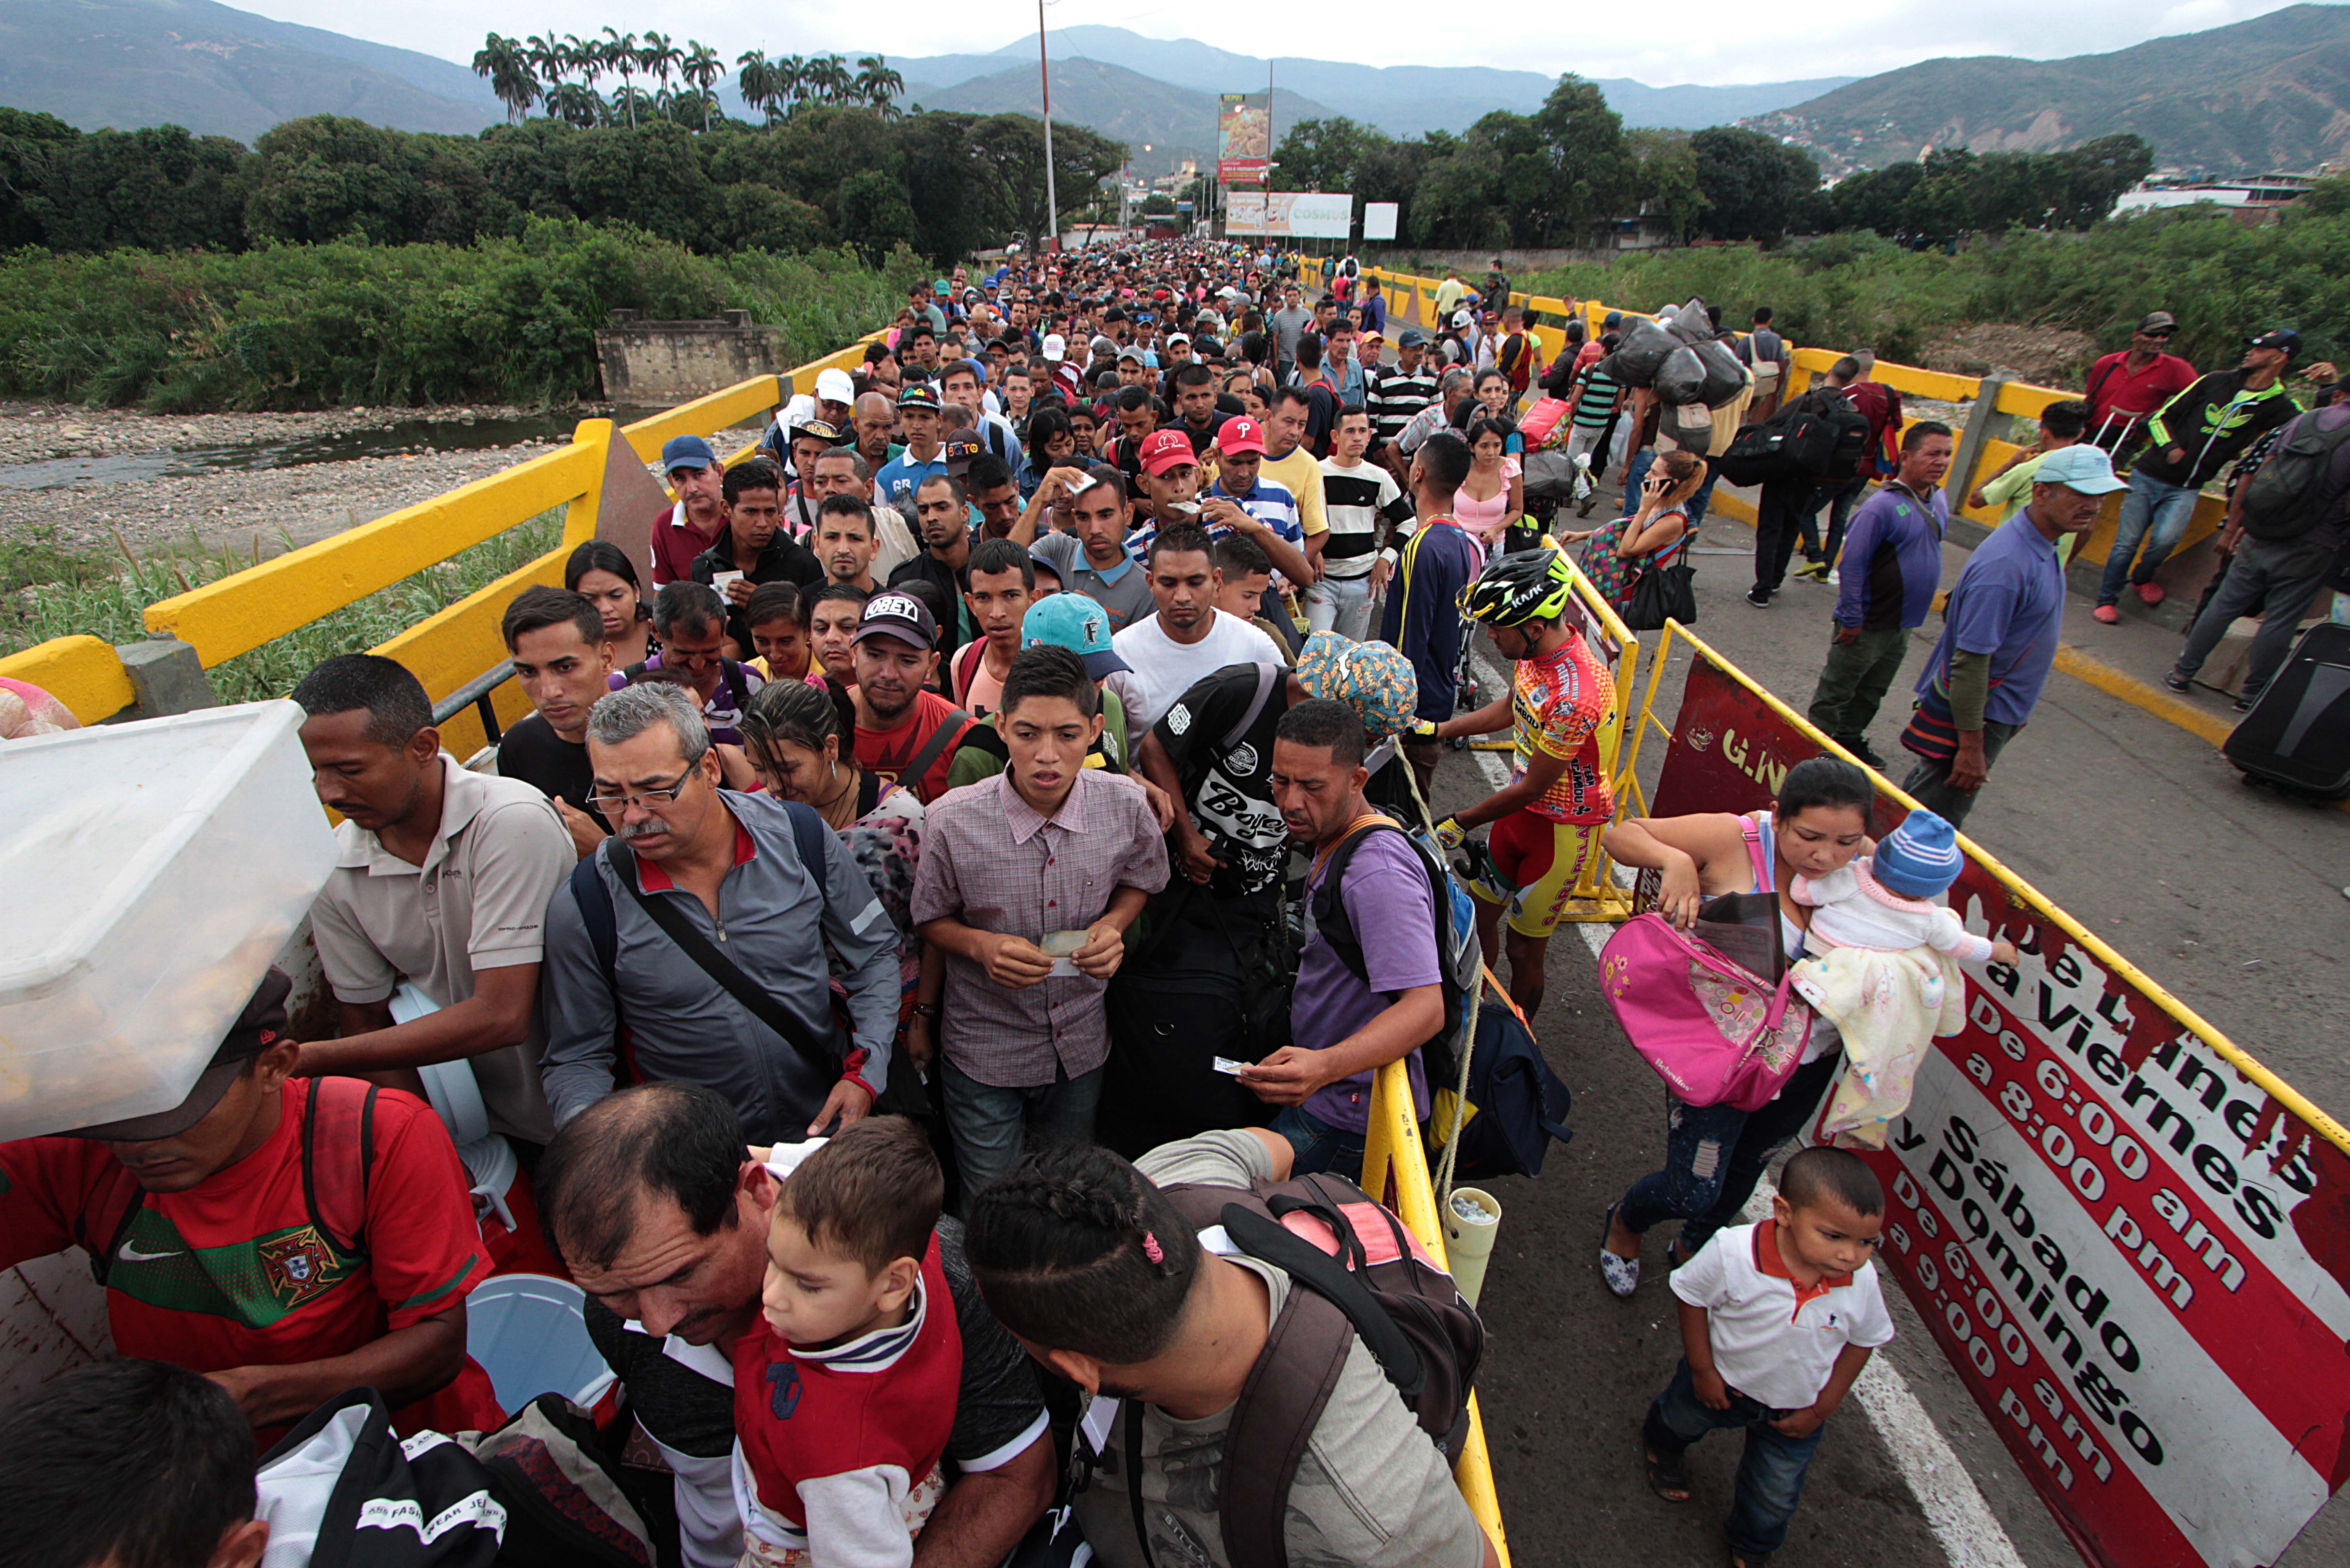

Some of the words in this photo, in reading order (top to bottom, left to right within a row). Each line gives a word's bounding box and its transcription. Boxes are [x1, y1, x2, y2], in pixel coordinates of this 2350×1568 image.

[1293, 208, 1349, 220] COSMOS
[948, 443, 978, 457] BQTO
[1237, 422, 1251, 438] P
[869, 598, 914, 615] OBEY
[1511, 584, 1543, 608] KASK
[1570, 757, 1585, 804] ACAMBOU
[1655, 1057, 1689, 1091] Bebesitos
[1986, 961, 2021, 998] a
[2039, 979, 2284, 1240] Viernes
[1969, 993, 2027, 1062] De
[2036, 1058, 2150, 1181] 6:00
[2151, 1187, 2247, 1294] am
[1965, 1051, 1995, 1088] a
[1999, 1080, 2107, 1202] 8:00
[2104, 1204, 2196, 1311] pm
[1943, 1115, 2141, 1373] Sábado
[1894, 1115, 1926, 1151] y
[1929, 1148, 2164, 1466] Domingo
[1892, 1170, 1939, 1239] De
[1944, 1241, 2030, 1368] 6:00
[2032, 1377, 2114, 1485] am
[1889, 1222, 1911, 1256] a
[1916, 1253, 1997, 1379] 9:00
[1998, 1385, 2075, 1493] pm
[391, 1506, 423, 1520] FASH
[426, 1507, 462, 1535] WEAR
[1165, 1515, 1204, 1563] BILLA
